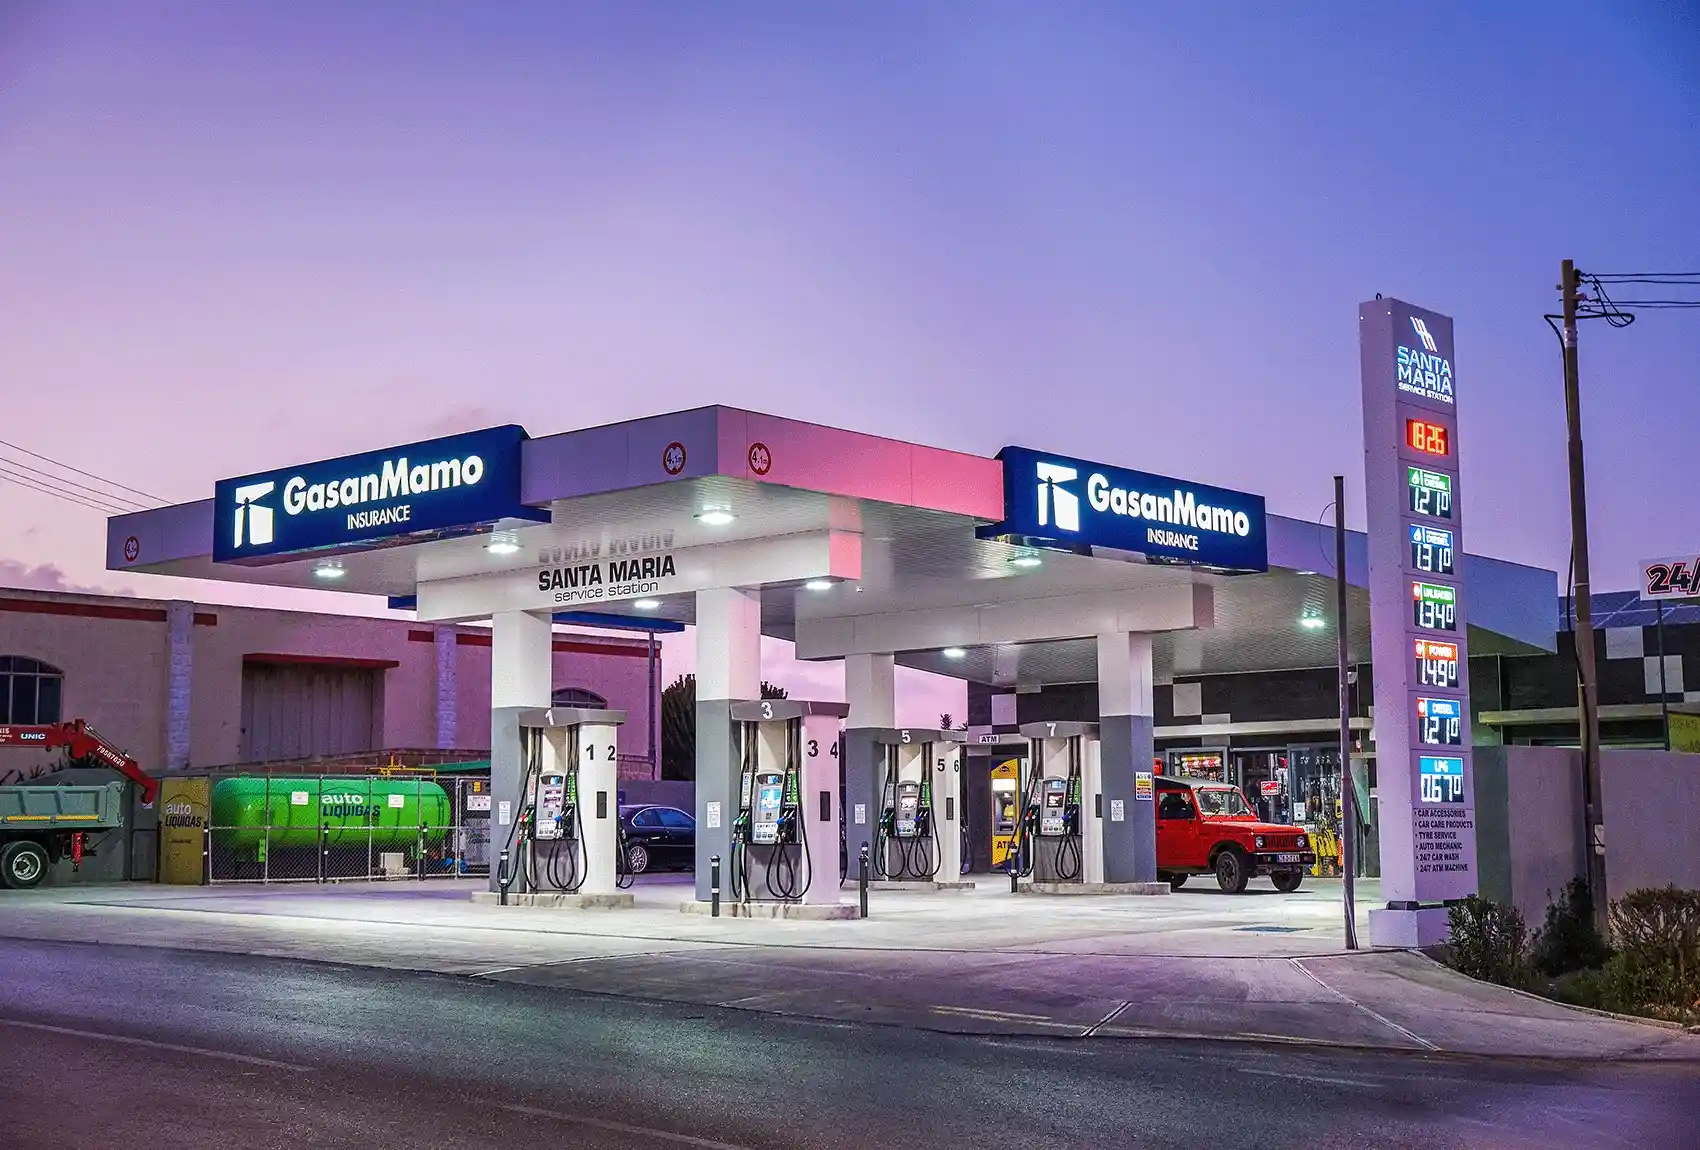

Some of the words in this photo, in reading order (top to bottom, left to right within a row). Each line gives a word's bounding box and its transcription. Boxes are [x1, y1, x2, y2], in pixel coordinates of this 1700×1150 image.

[1397, 345, 1452, 379] SANTA
[1397, 362, 1453, 396] MARIA
[1398, 381, 1426, 397] SERVICE
[1426, 389, 1453, 405] STATION
[283, 455, 484, 516] GasanMamo
[1087, 473, 1250, 537] GasanMamo
[347, 505, 411, 530] INSURANCE
[1147, 528, 1199, 551] INSURANCE
[538, 564, 602, 592] SANTA
[609, 555, 676, 583] MARIA
[554, 586, 604, 602] service
[608, 580, 659, 597] station
[545, 709, 554, 725] 1
[760, 701, 773, 719] 3
[901, 730, 911, 743] 5
[1046, 722, 1057, 737] 7
[981, 735, 997, 743] ATM
[585, 744, 595, 761] 1
[607, 745, 616, 761] 2
[807, 740, 819, 757] 3
[830, 741, 839, 759] 4
[937, 758, 946, 772] 5
[953, 759, 960, 772] 6
[1433, 759, 1449, 773] LPG
[321, 793, 364, 804] auto
[166, 803, 191, 815] auto
[323, 805, 380, 818] LIQUIGAS
[1418, 809, 1429, 818] CAR
[1430, 809, 1466, 818] ACCESSORIES
[1418, 820, 1430, 828] CAR
[1431, 820, 1445, 828] CARE
[1446, 820, 1473, 828] PRODUCTS
[1434, 831, 1457, 839] SERVICE
[1419, 842, 1434, 850] AUTO
[1435, 842, 1463, 850] MECHANIC
[1432, 853, 1443, 861] CAR
[1444, 853, 1460, 861] WASH
[1432, 864, 1444, 872] ATM
[1445, 863, 1468, 872] MACHINE
